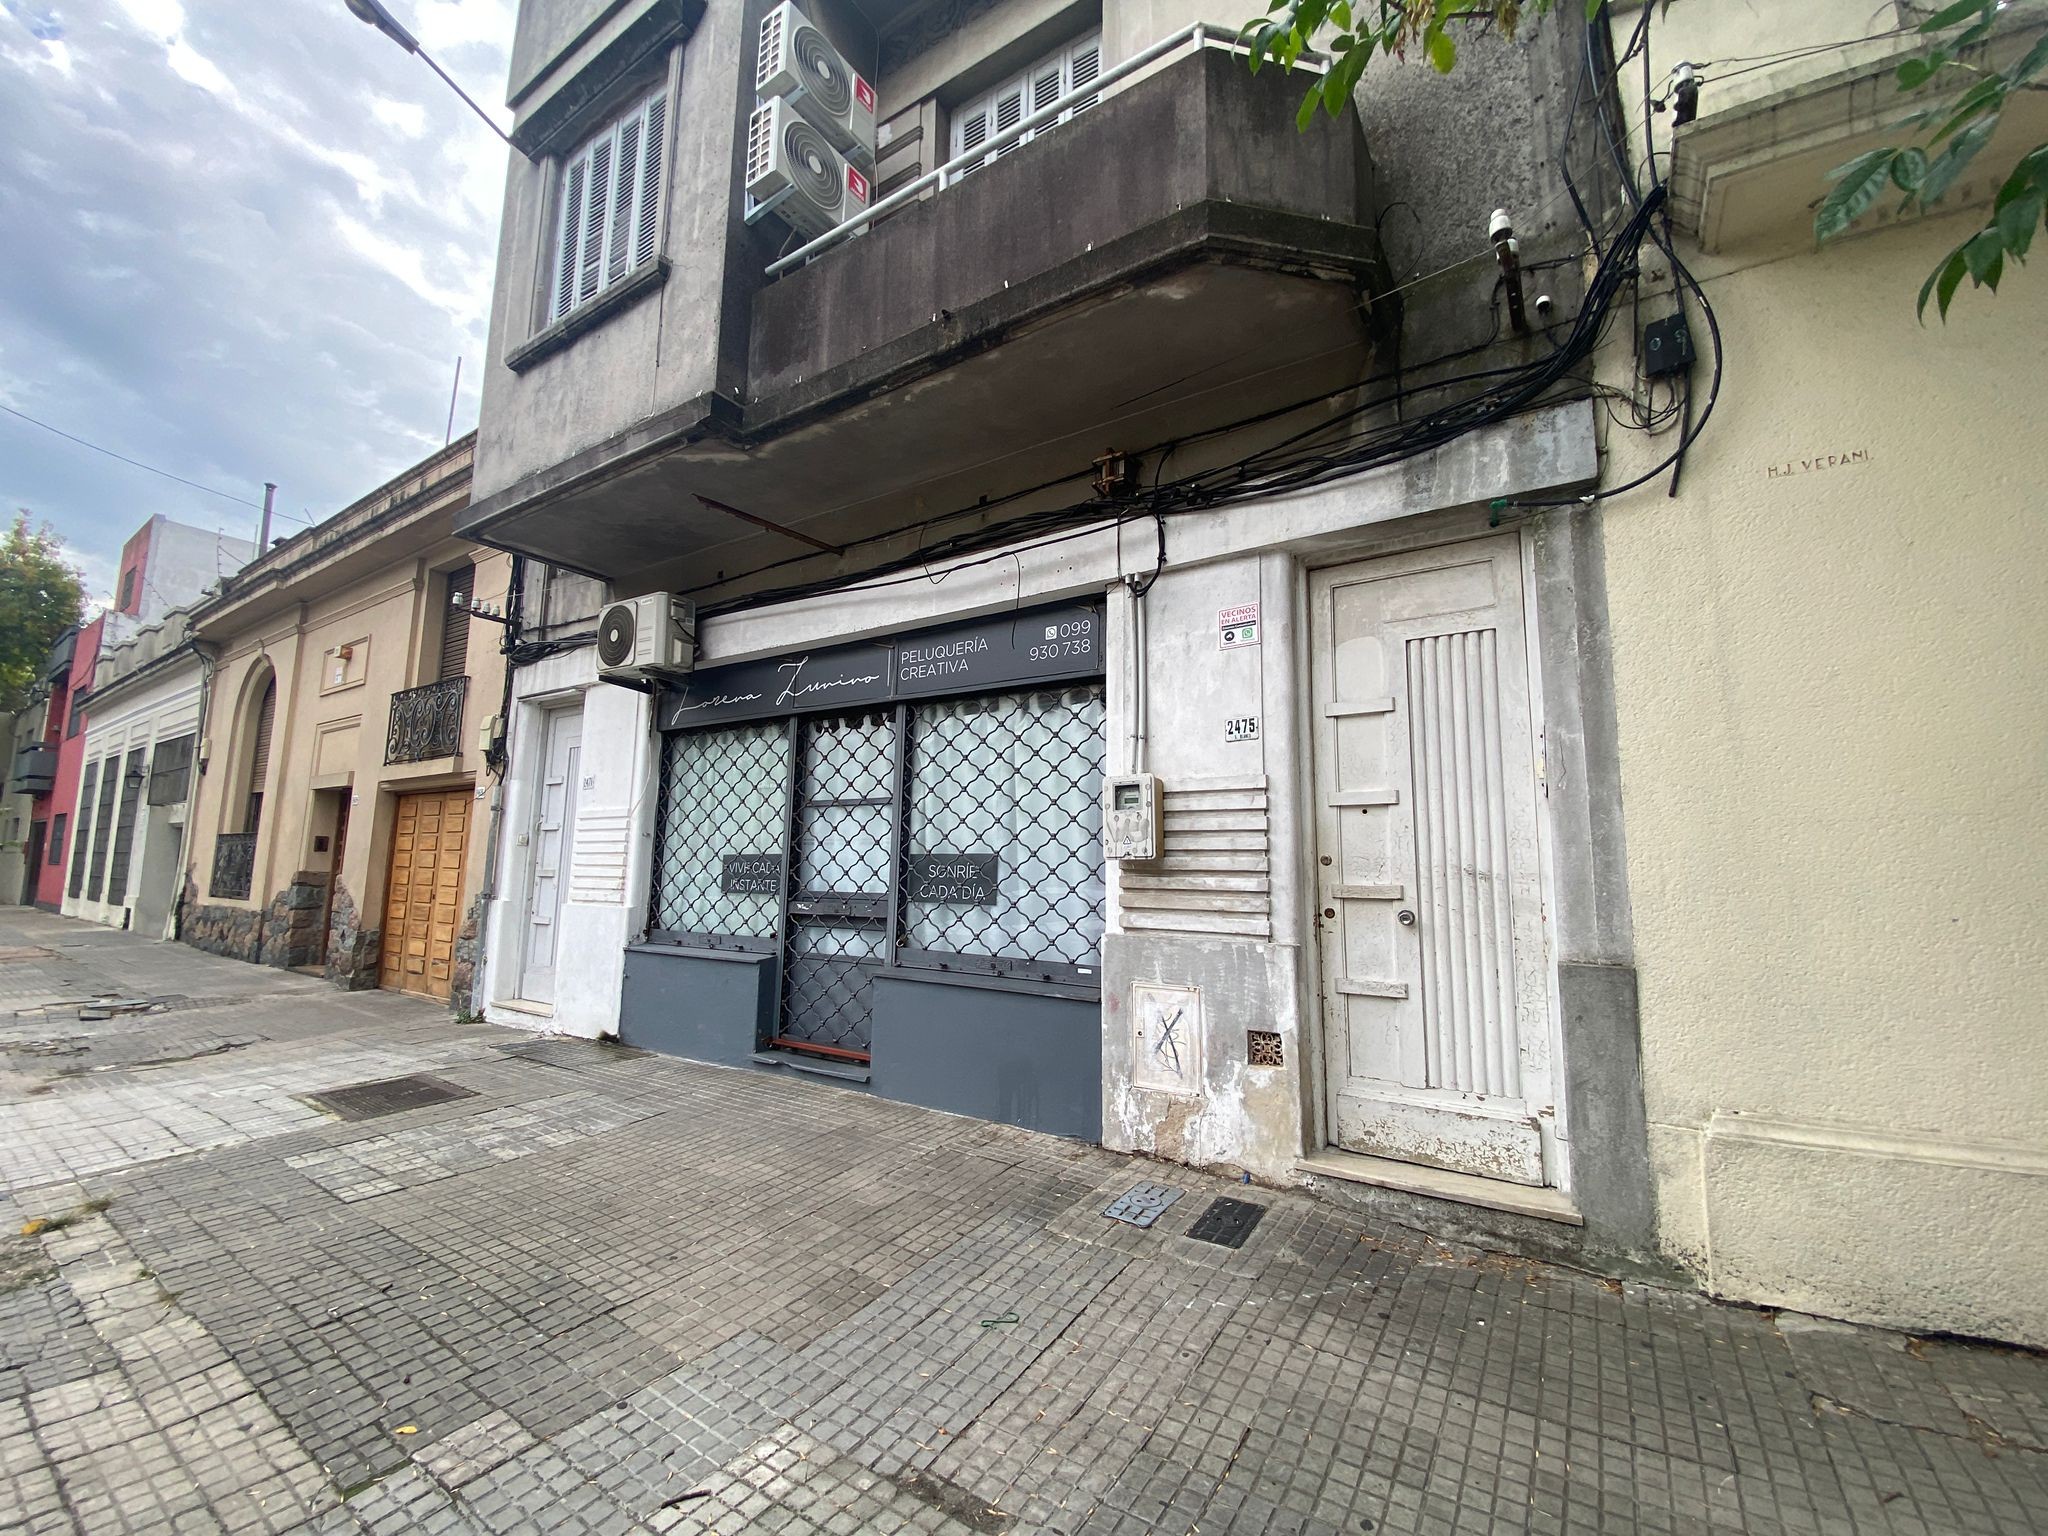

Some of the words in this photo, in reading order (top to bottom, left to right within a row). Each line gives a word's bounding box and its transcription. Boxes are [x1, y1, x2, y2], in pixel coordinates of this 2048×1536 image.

[1221, 606, 1256, 618] VECINOS
[1231, 614, 1256, 623] ALERTA
[1060, 620, 1091, 638] 099
[901, 636, 989, 664] PELUQUERÍA
[1029, 644, 1059, 661] 930
[1062, 639, 1091, 655] 738
[900, 659, 969, 680] CREATIVA
[671, 687, 762, 726] Lorena
[776, 656, 880, 706] Zunino
[1227, 718, 1255, 735] 2475
[920, 885, 958, 899] CADA
[962, 883, 986, 901] DÍA
